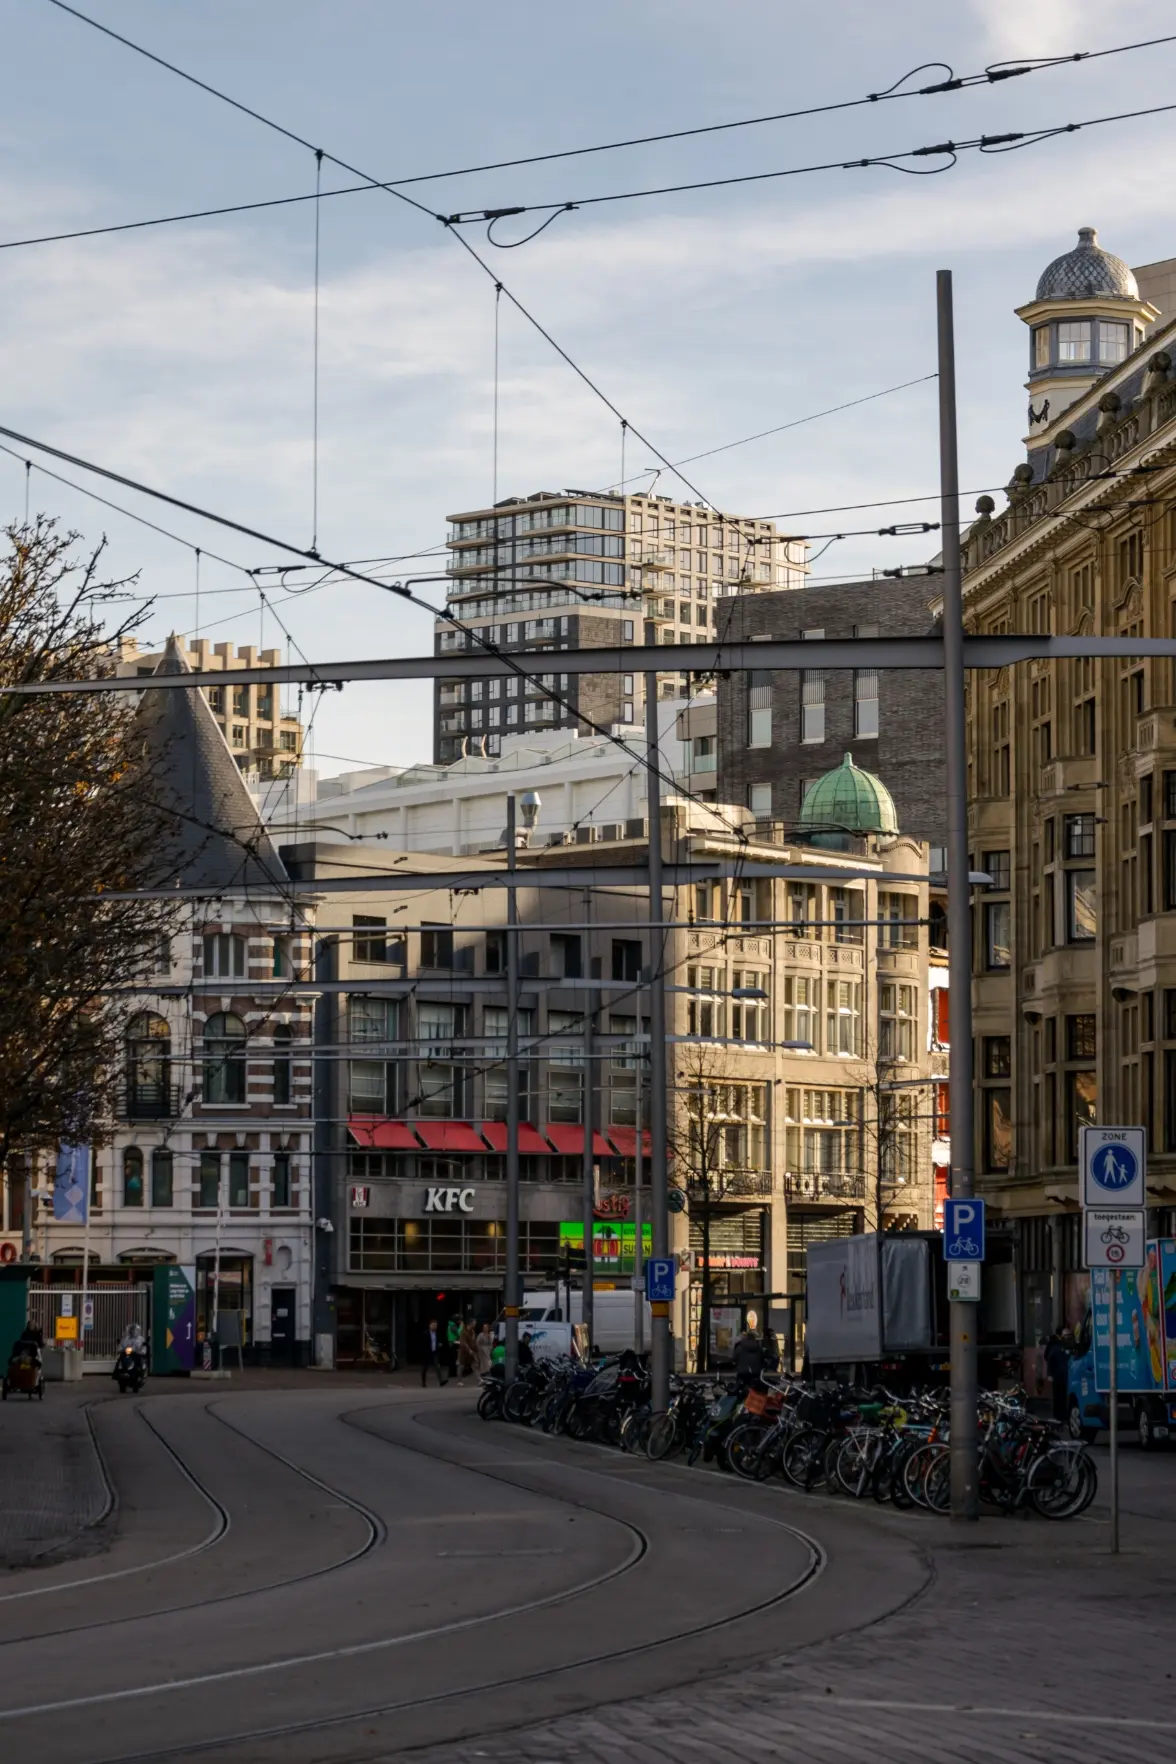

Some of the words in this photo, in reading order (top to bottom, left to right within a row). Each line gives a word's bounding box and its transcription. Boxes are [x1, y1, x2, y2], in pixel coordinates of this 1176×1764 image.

[1101, 1133, 1127, 1141] ZONE
[425, 1187, 476, 1213] KFC
[953, 1204, 976, 1236] P
[1094, 1213, 1137, 1223] toegestaan:
[624, 1244, 651, 1254] SUN
[654, 1262, 669, 1283] P
